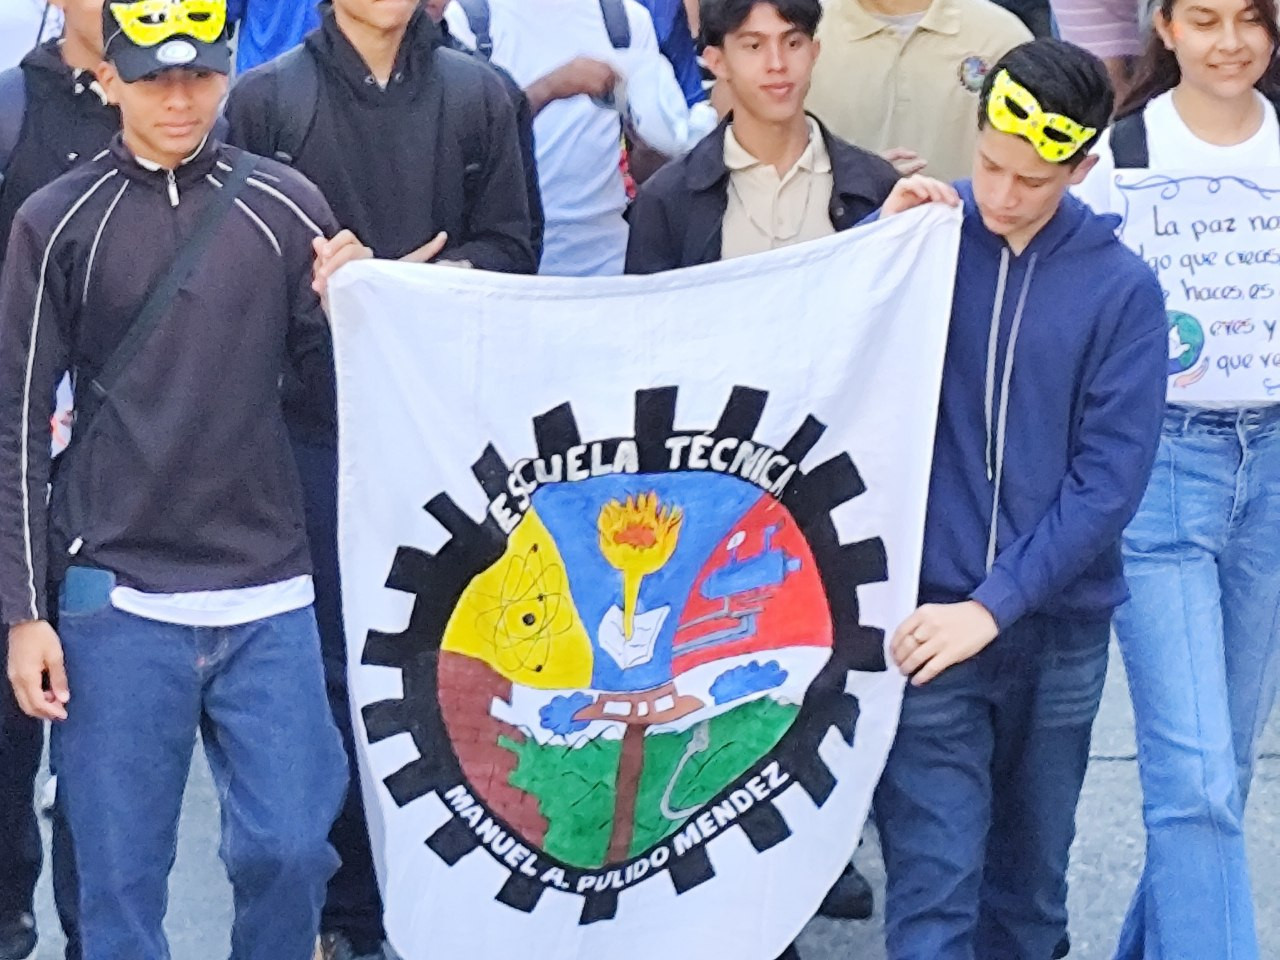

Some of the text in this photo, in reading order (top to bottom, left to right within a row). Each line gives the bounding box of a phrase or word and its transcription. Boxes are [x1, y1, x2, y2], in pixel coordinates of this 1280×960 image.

[1152, 204, 1180, 236] La
[1191, 217, 1236, 242] paz
[1180, 251, 1218, 275] que
[1249, 283, 1274, 299] es
[1209, 318, 1255, 336] eres
[1216, 354, 1253, 377] que
[489, 439, 640, 534] ESCUELA
[444, 760, 791, 893] MANUEL A. PULIDO MENDEZ
